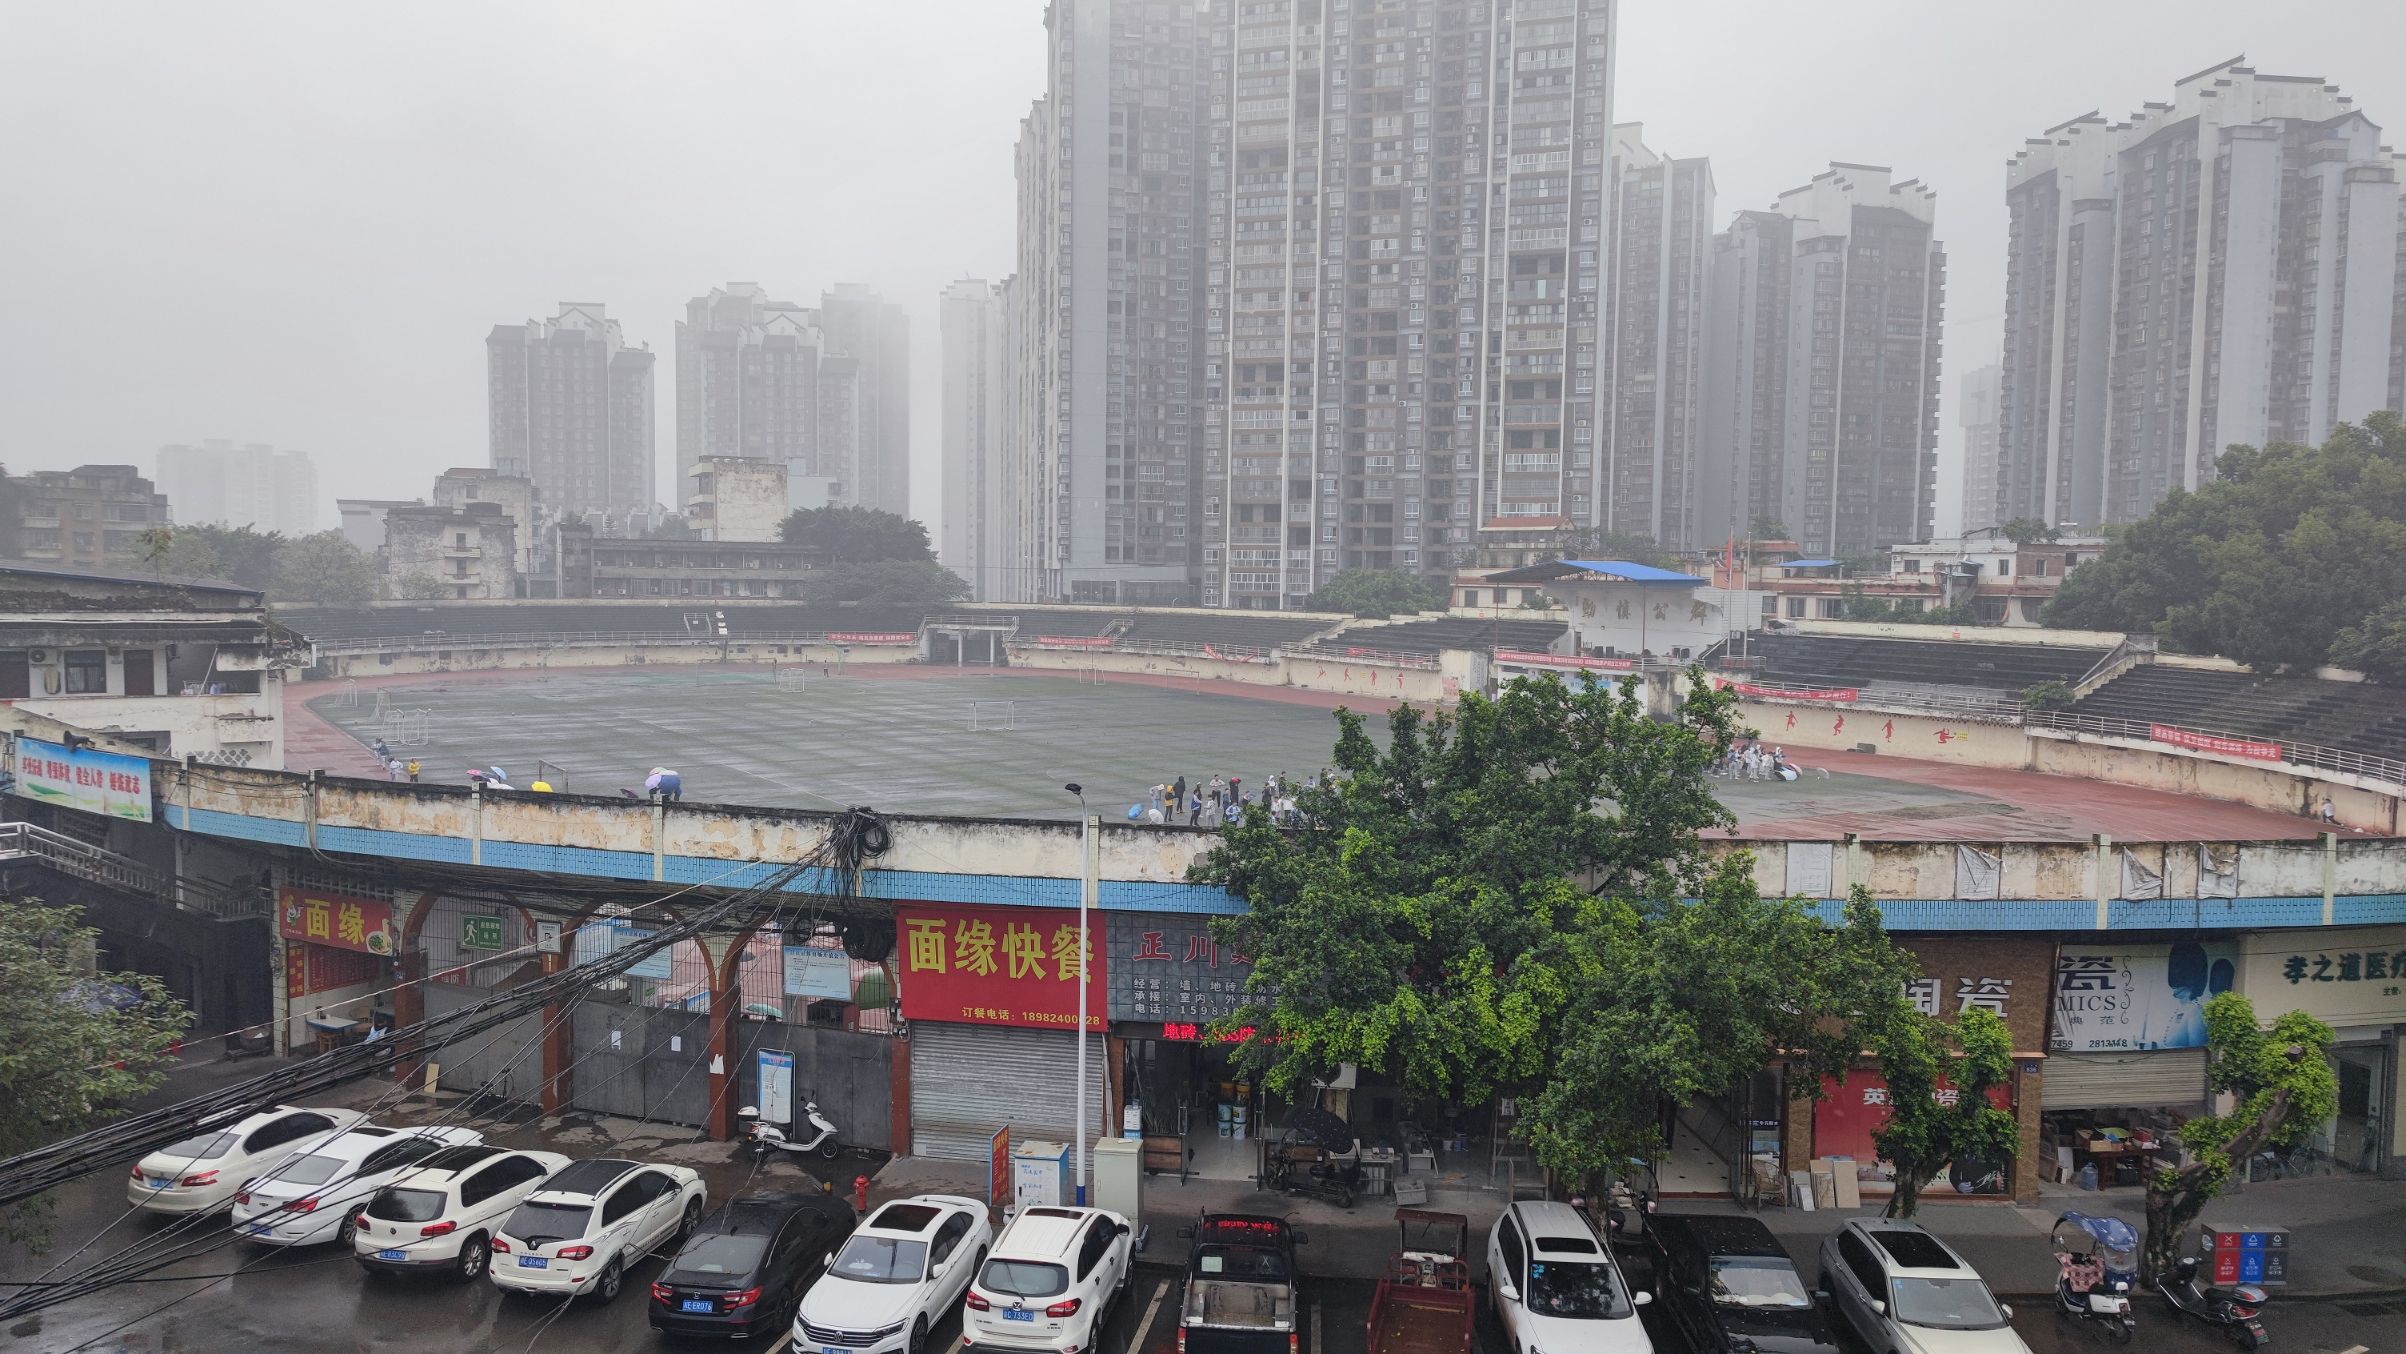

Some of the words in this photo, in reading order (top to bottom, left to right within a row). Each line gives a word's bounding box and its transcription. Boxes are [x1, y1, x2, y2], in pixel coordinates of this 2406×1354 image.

[304, 898, 366, 945] 面缘
[906, 918, 1095, 984] 面缘快餐
[2059, 955, 2117, 991] 瓷
[961, 1006, 1100, 1026] 订餐电话：1898240028
[1862, 1087, 1961, 1107] 英瓷
